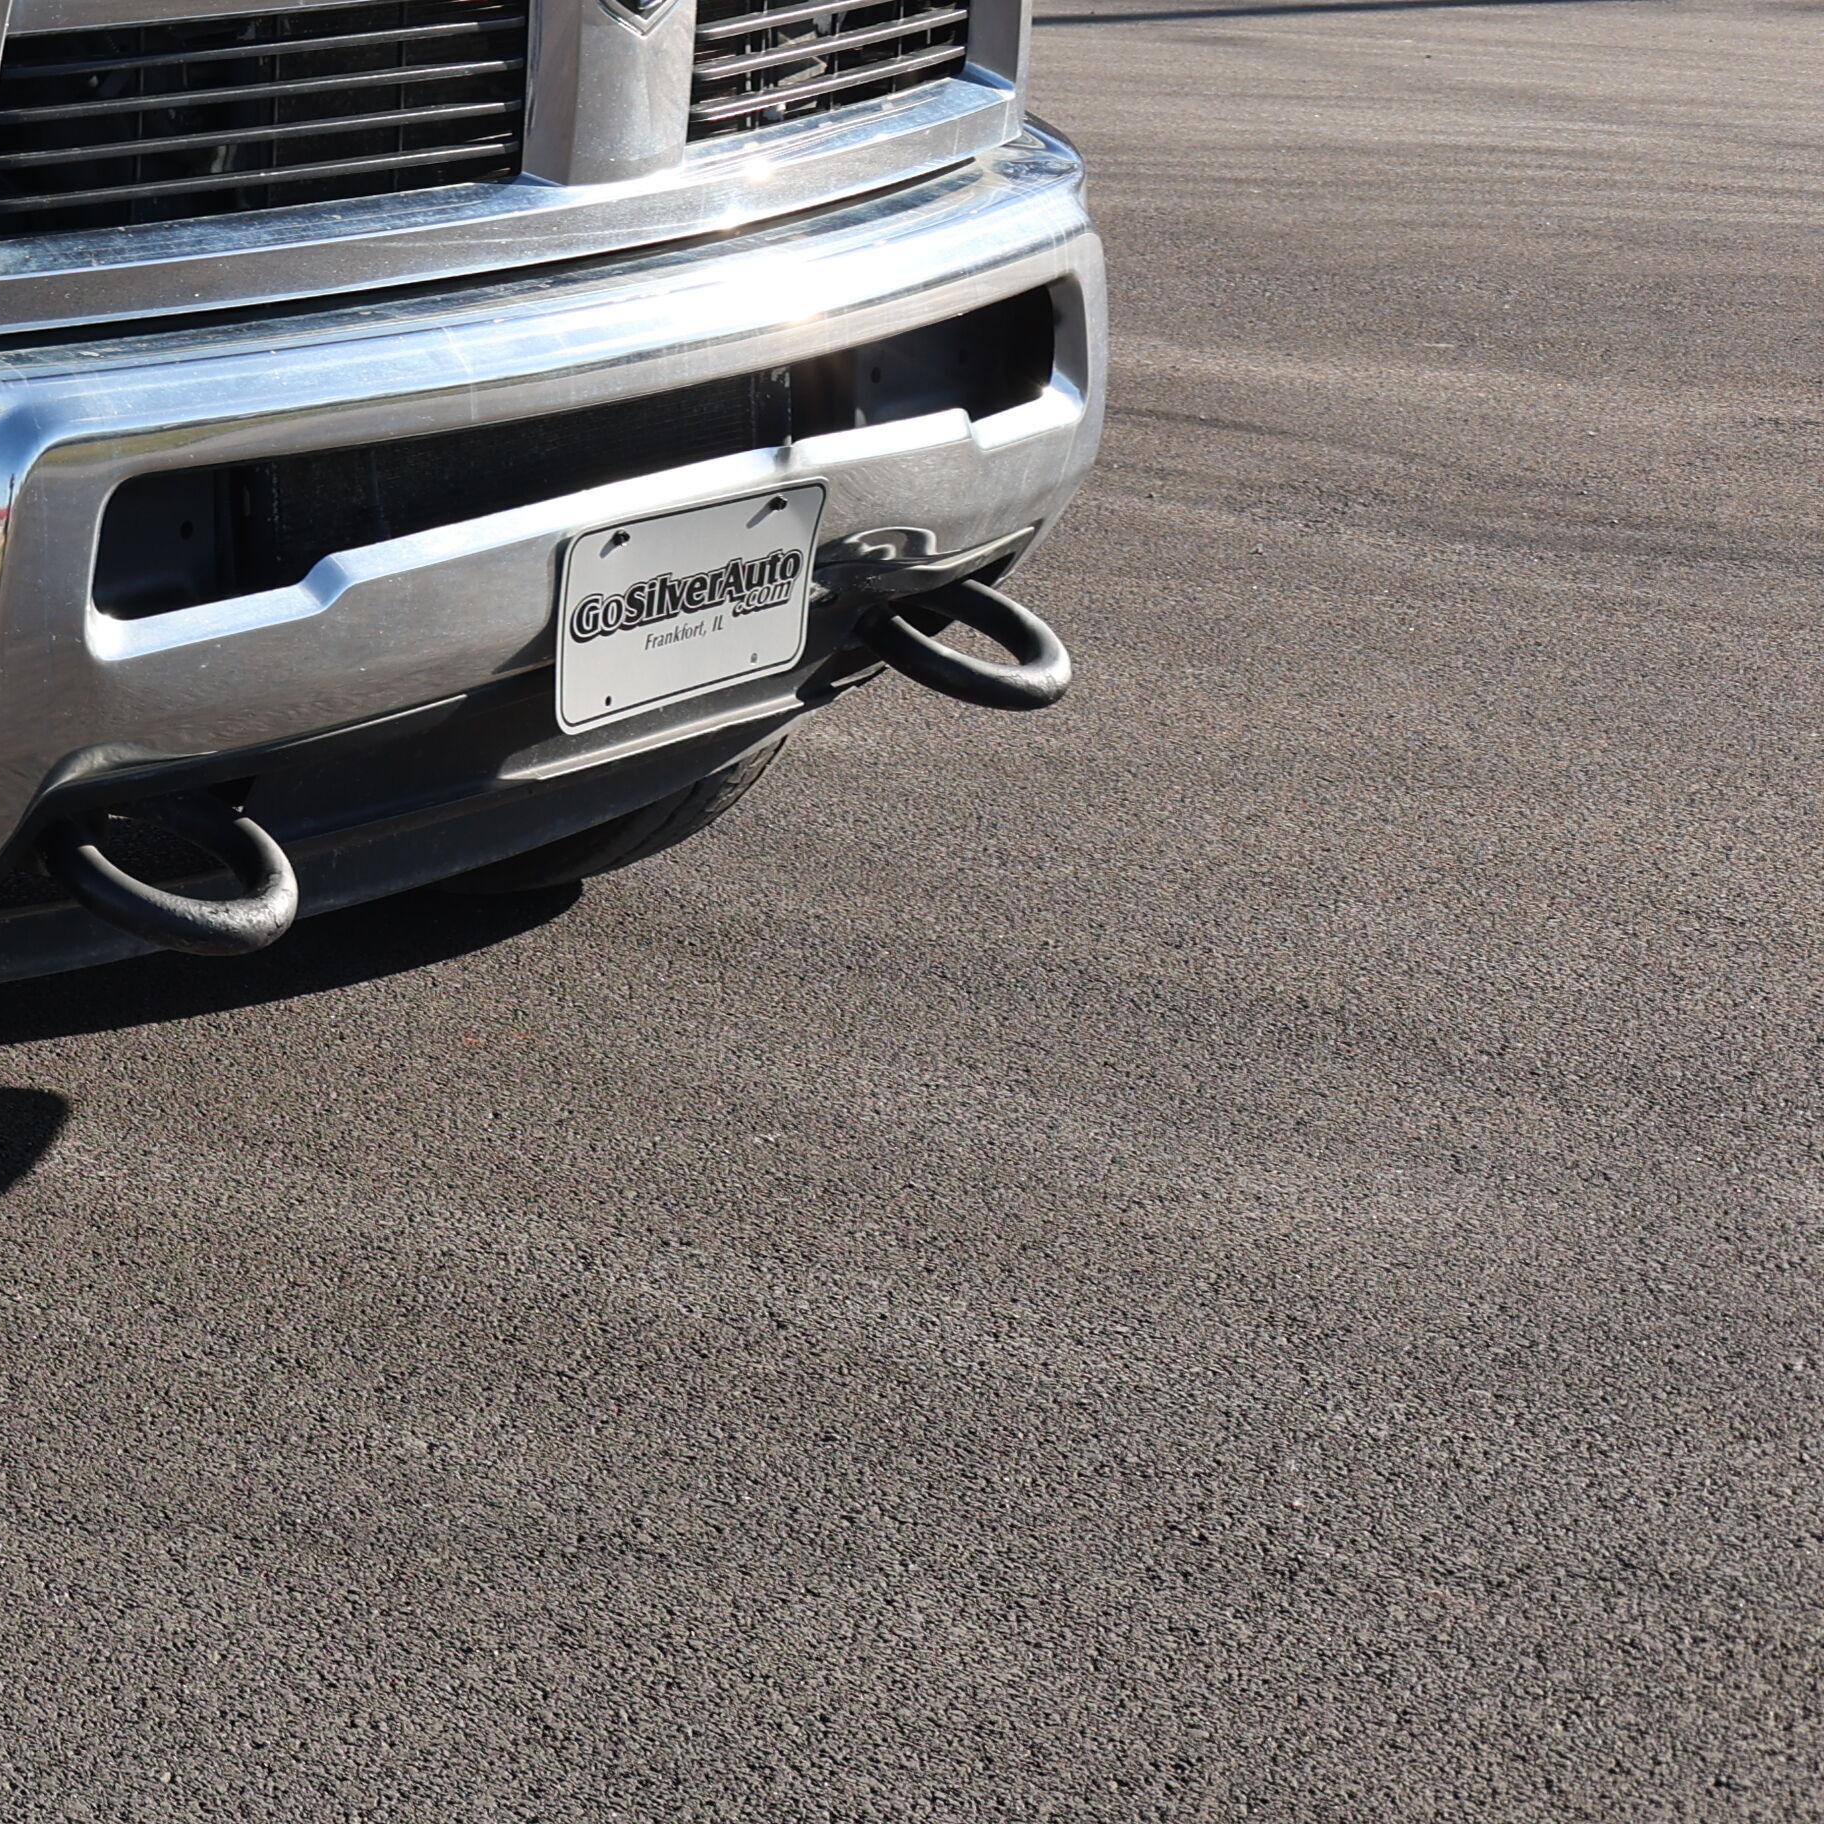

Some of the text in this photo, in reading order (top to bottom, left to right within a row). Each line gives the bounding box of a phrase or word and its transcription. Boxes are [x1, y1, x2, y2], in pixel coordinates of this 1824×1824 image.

[571, 549, 803, 642] GoSilverAuto
[732, 580, 792, 617] .com
[644, 615, 724, 651] Frankfort, IL
